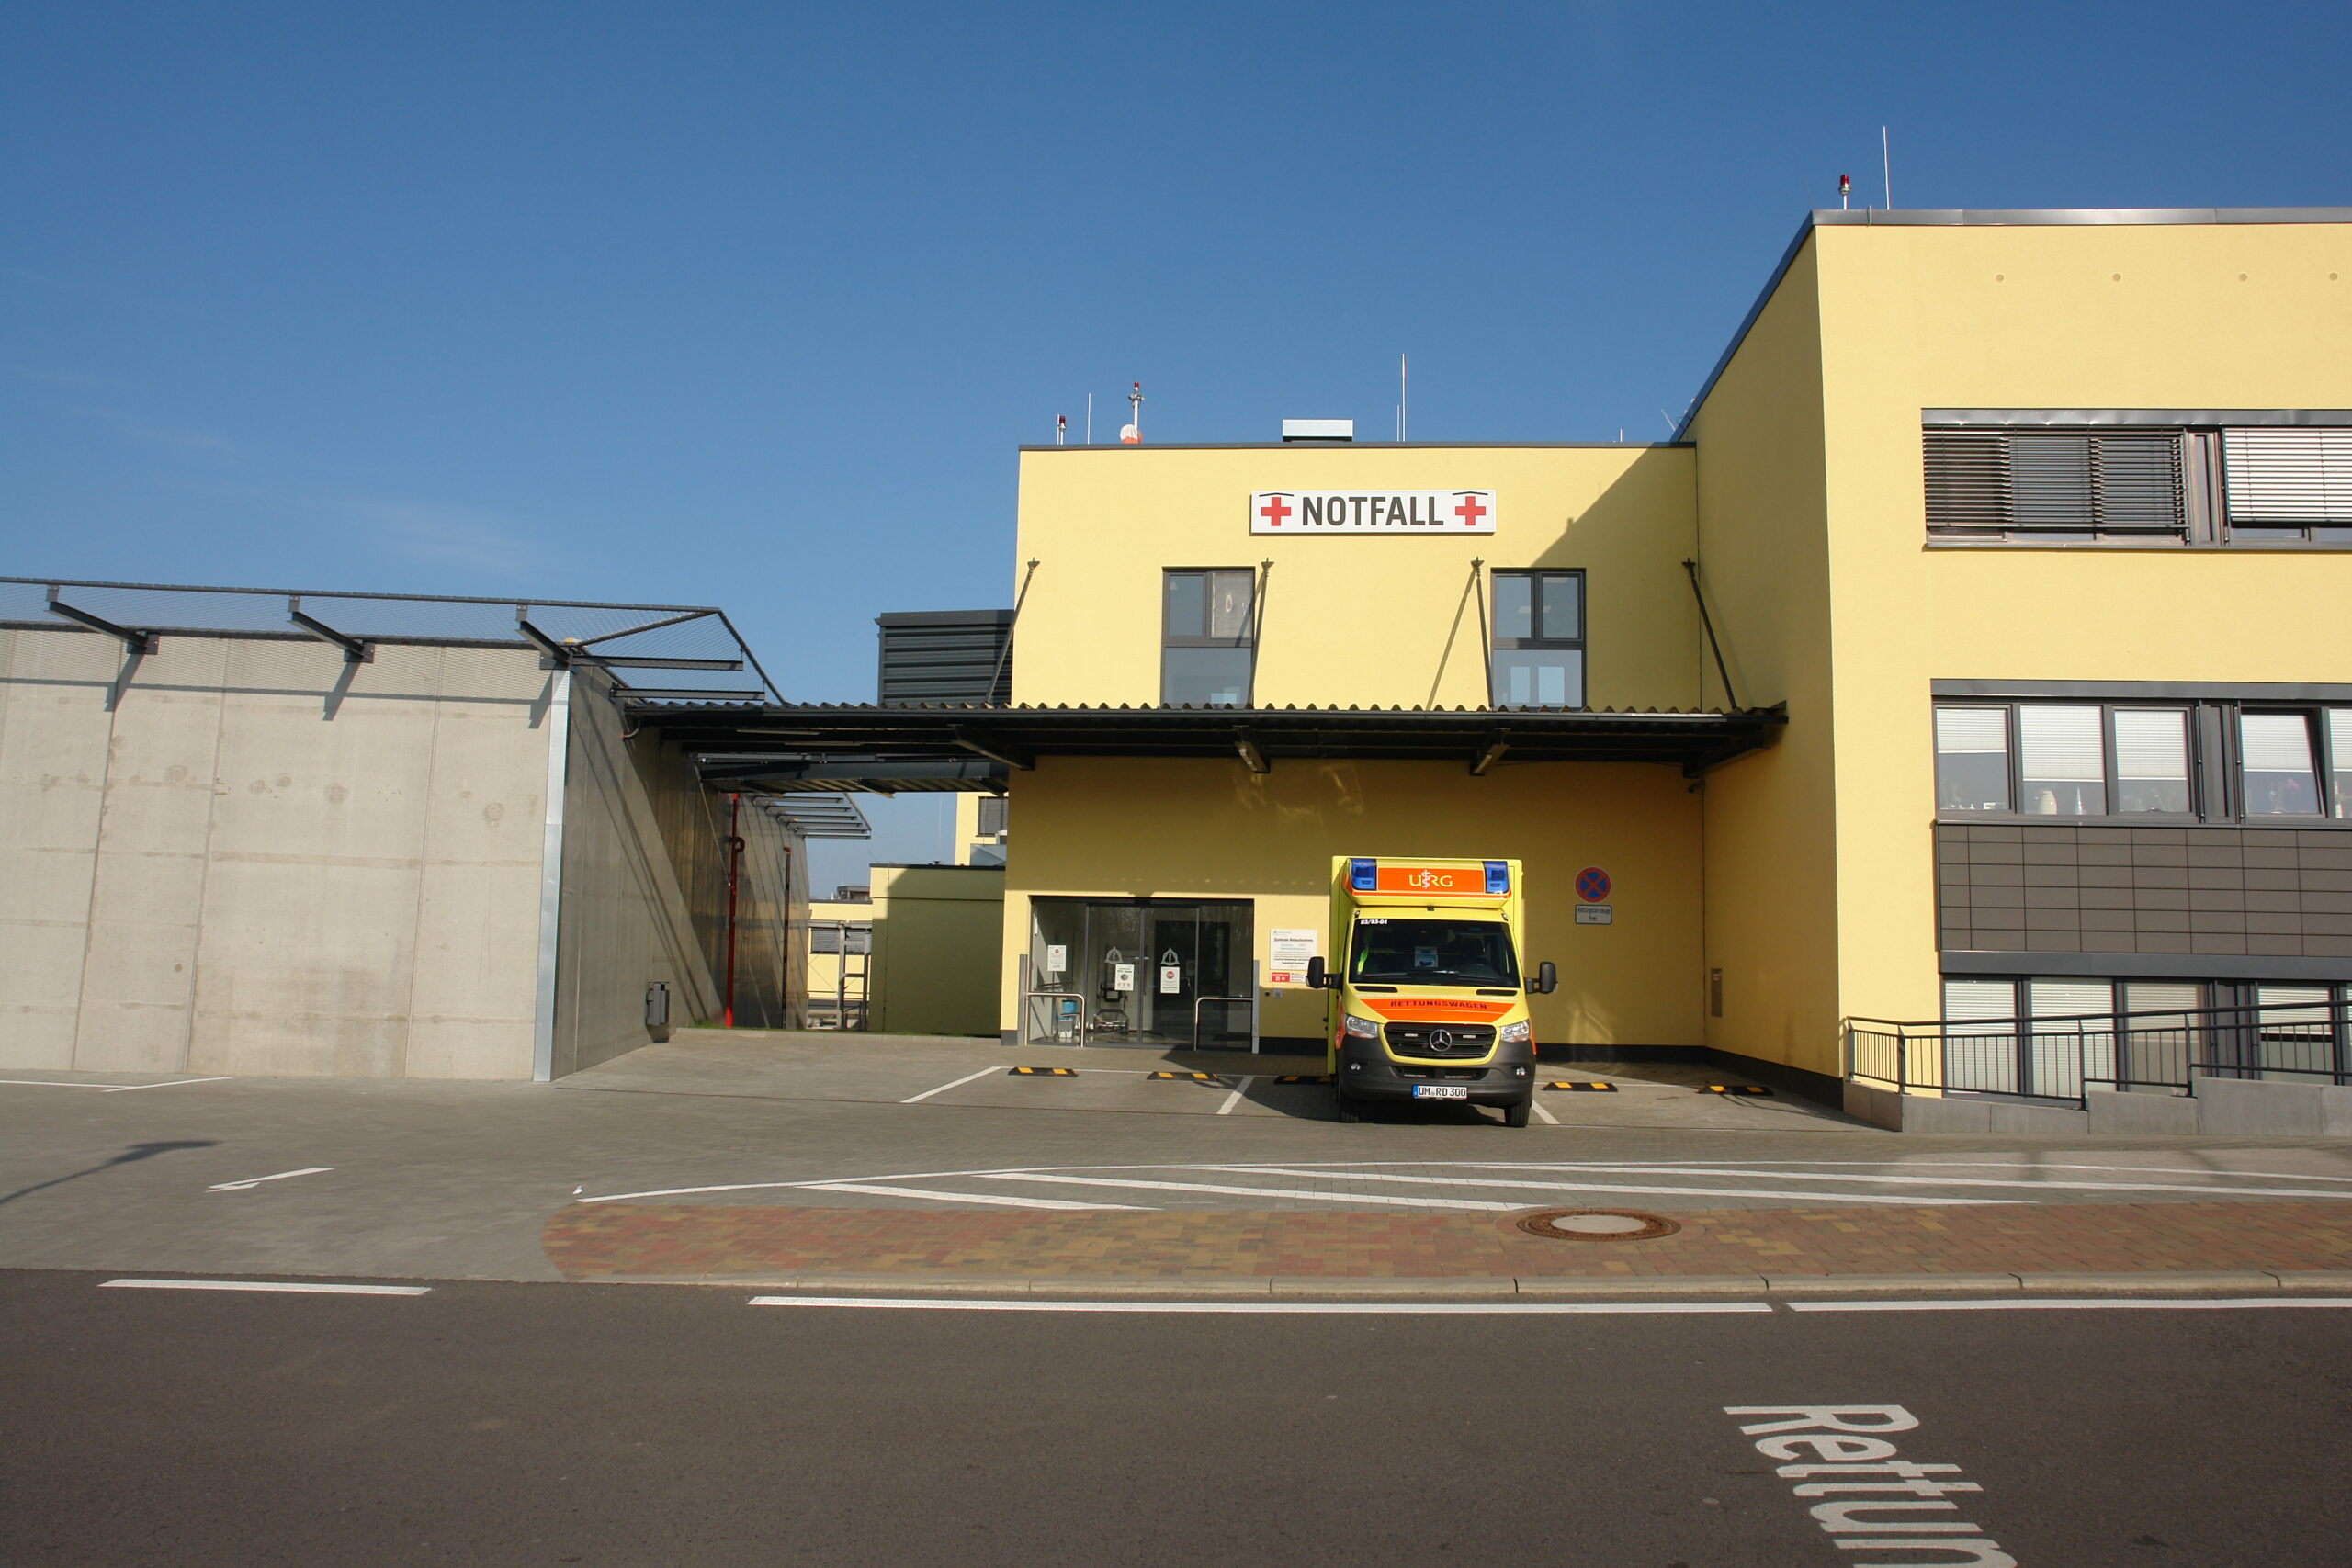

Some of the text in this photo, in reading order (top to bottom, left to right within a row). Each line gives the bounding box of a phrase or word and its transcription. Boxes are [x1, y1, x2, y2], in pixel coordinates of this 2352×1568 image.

[1302, 496, 1444, 526] NOTFALL
[1390, 999, 1488, 1010] RETTUNGSWAGEN
[1419, 1087, 1466, 1097] UM RD 300
